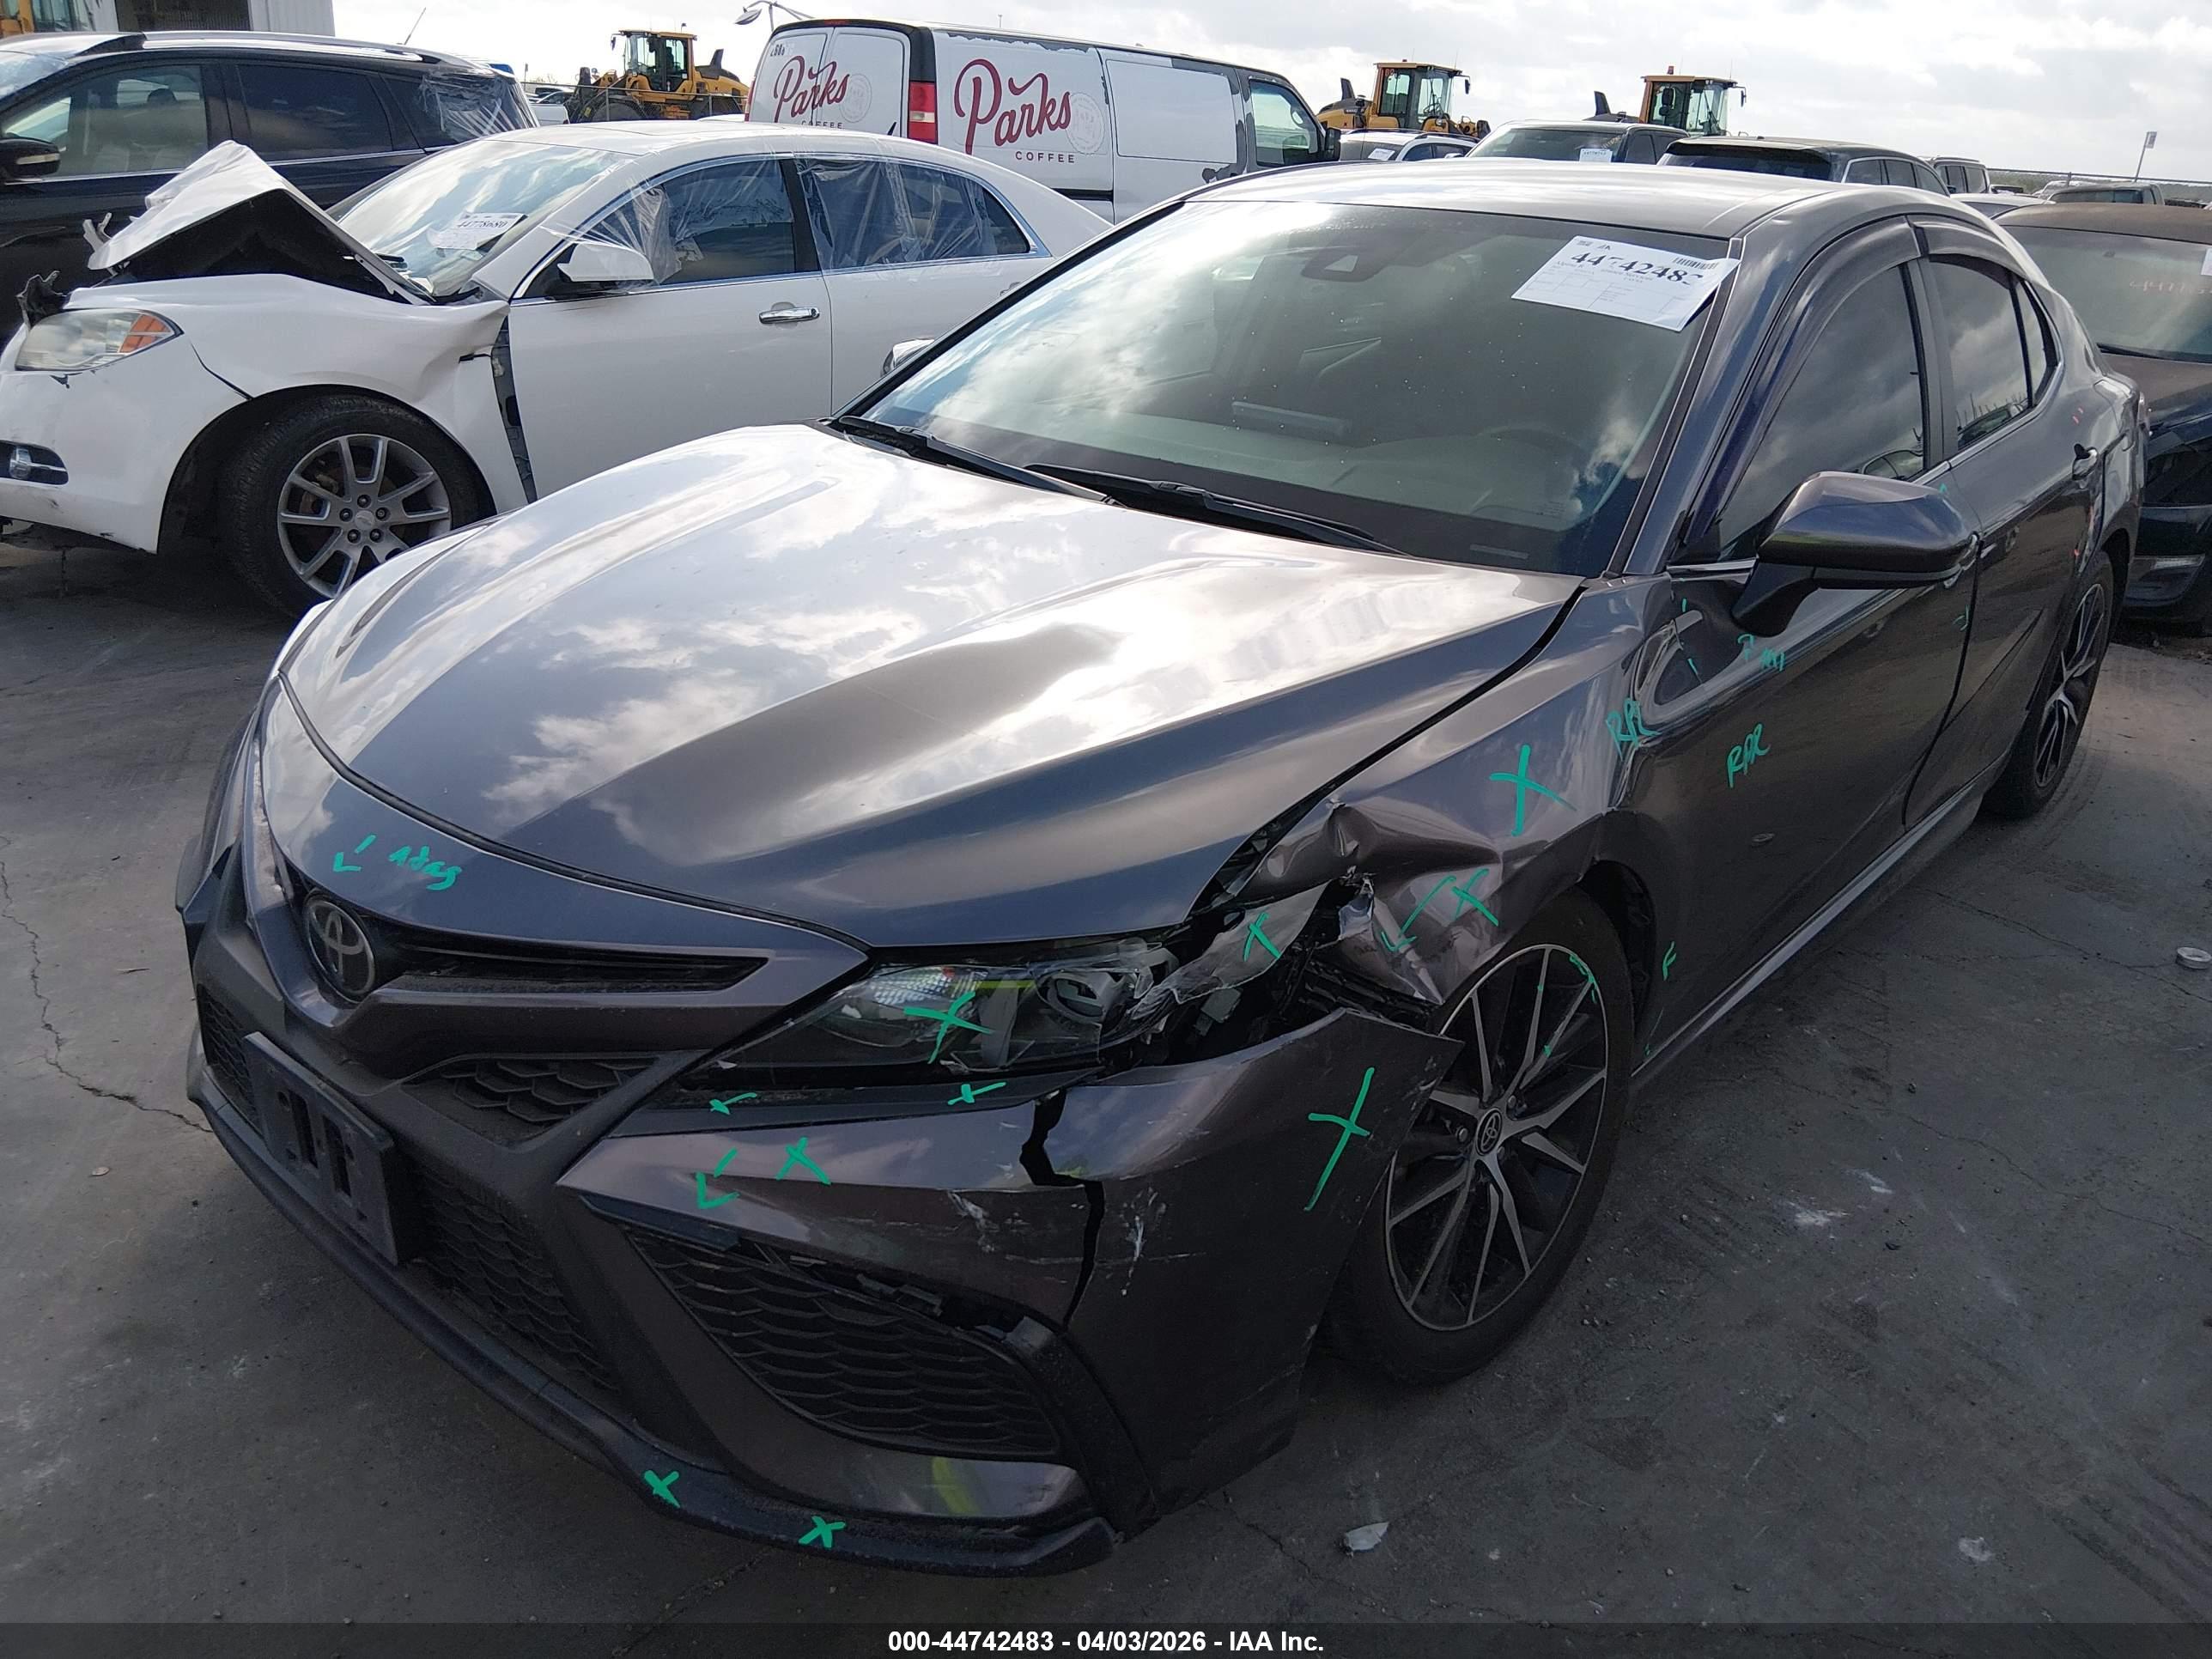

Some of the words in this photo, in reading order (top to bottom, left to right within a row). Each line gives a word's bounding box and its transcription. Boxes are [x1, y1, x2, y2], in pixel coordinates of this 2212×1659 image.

[773, 55, 850, 123] Parks
[954, 58, 1071, 155] Parks
[801, 120, 845, 129] COFFEE
[1015, 151, 1075, 163] COFFEE
